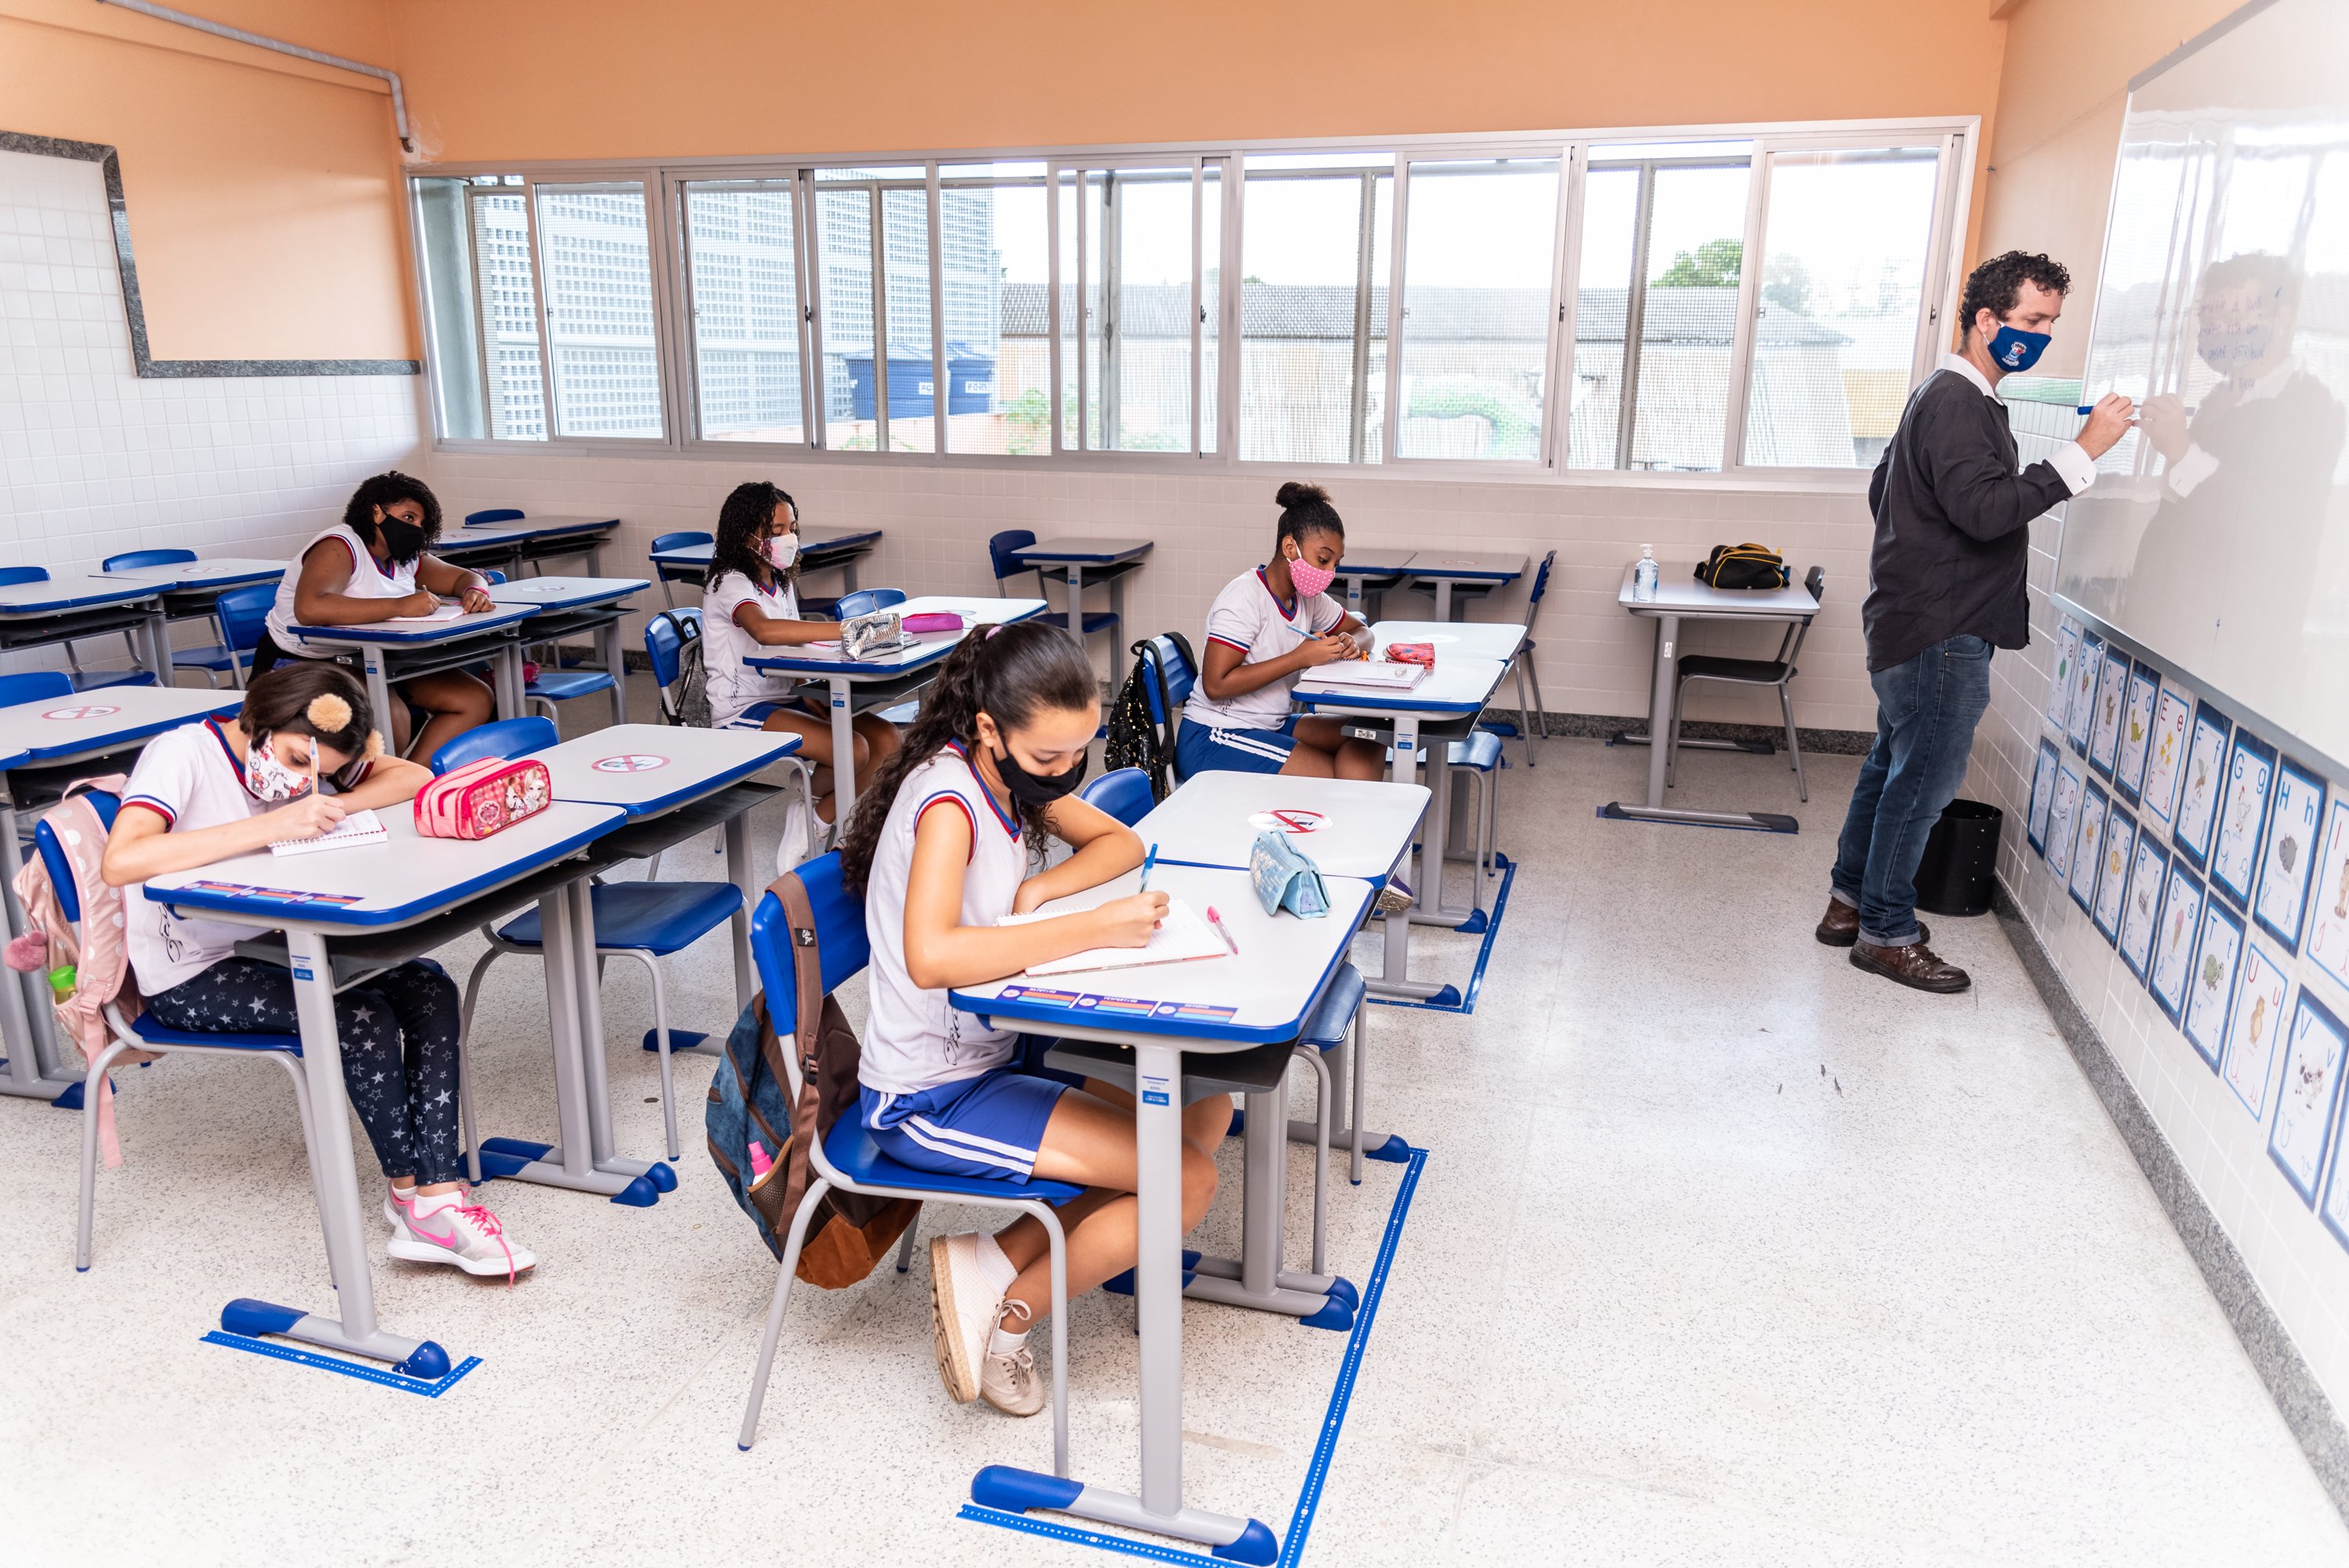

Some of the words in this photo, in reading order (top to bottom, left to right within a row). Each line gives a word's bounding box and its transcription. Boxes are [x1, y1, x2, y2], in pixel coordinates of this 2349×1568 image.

[2068, 644, 2073, 658] a
[2080, 648, 2087, 667] B
[2091, 654, 2097, 674] b
[2105, 665, 2112, 684] C
[2117, 676, 2123, 691] c
[2131, 682, 2139, 703] D
[2145, 690, 2153, 712] d
[2160, 697, 2169, 722] E
[2177, 714, 2184, 732] e
[2195, 726, 2204, 749] F
[2214, 740, 2221, 764] f
[2059, 777, 2066, 796] O
[2069, 790, 2074, 804] o
[2234, 753, 2245, 780] G
[2256, 767, 2268, 795] g
[2084, 796, 2091, 815] P
[2279, 780, 2290, 811] H
[2304, 795, 2314, 826] h
[2111, 818, 2117, 840] Q
[2124, 836, 2130, 855] q
[2138, 847, 2147, 872] R
[2154, 871, 2160, 884] r
[2220, 829, 2231, 874] G
[2239, 858, 2248, 889] g
[2172, 878, 2180, 901] S
[2188, 903, 2194, 919] s
[2284, 899, 2293, 929] h
[2209, 915, 2217, 941] T
[2227, 937, 2233, 960] t
[2248, 953, 2260, 983] U
[2273, 986, 2281, 1007] u
[2300, 1008, 2313, 1040] V
[2326, 1047, 2336, 1069] v
